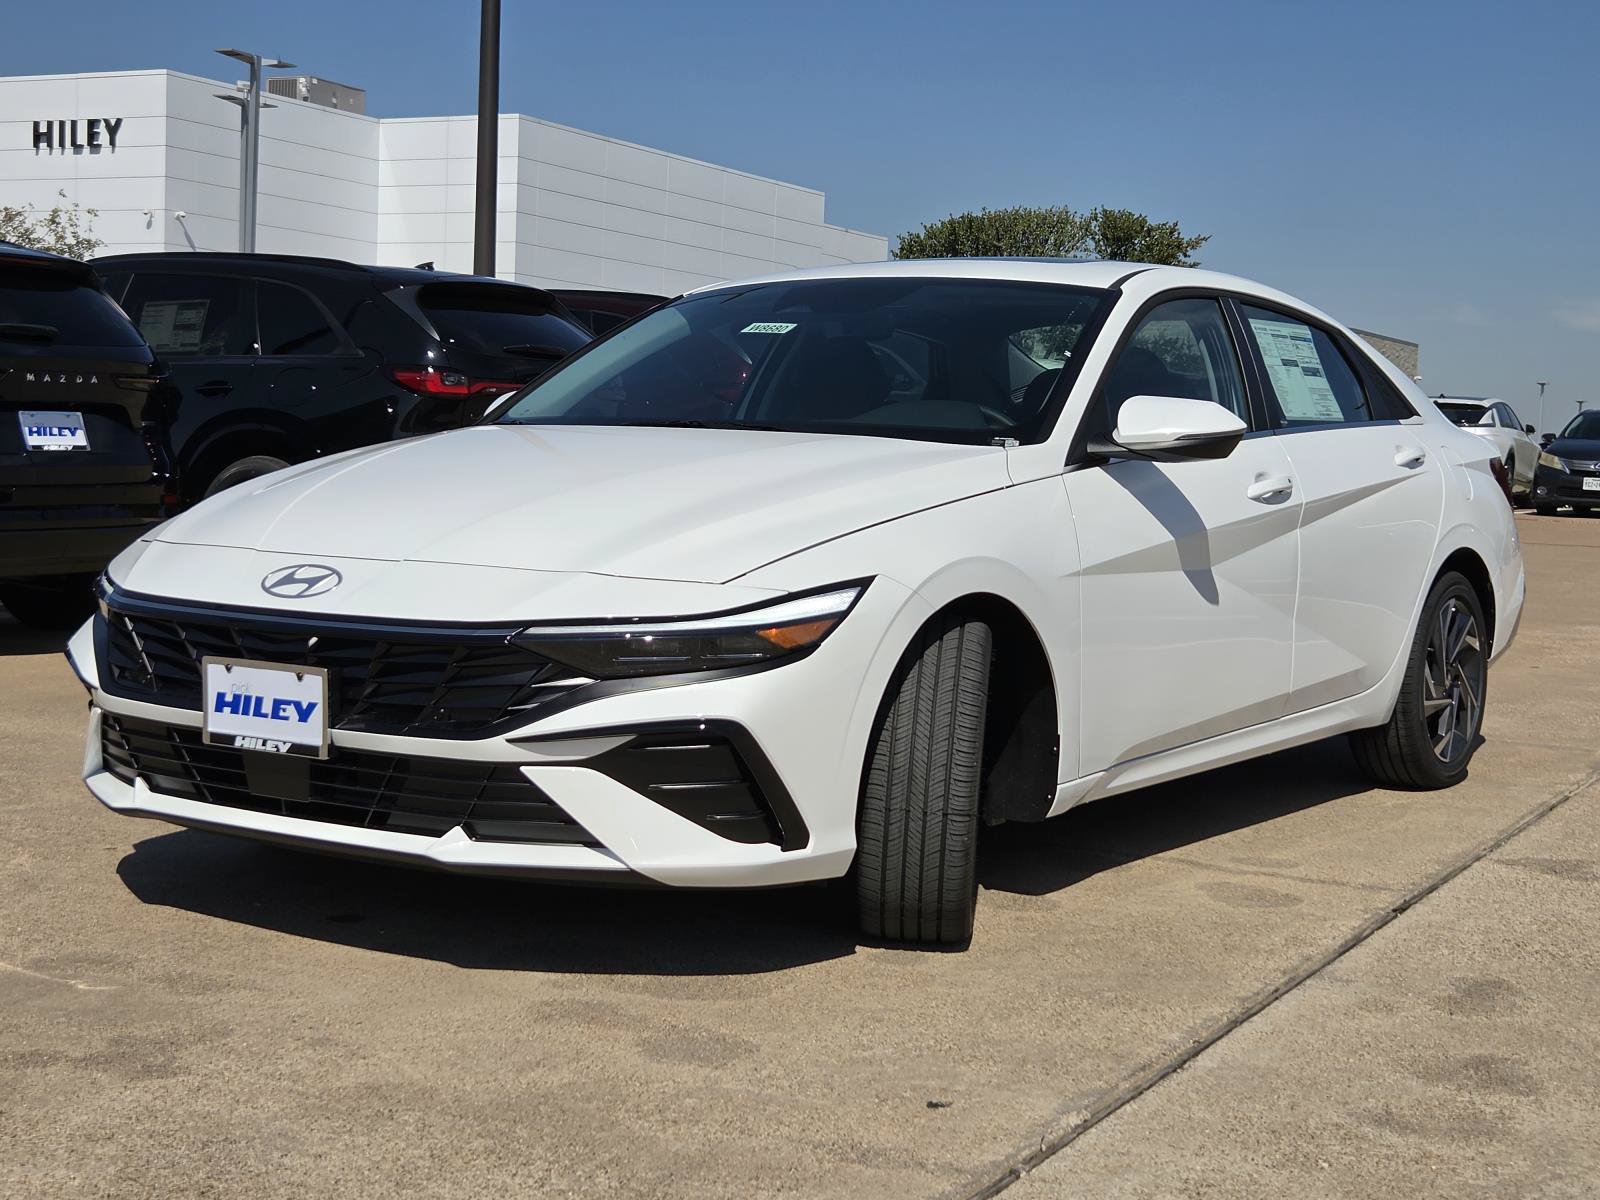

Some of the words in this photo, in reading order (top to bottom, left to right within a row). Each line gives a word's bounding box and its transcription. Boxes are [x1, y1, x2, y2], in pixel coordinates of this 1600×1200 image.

[32, 118, 123, 149] HILEY
[26, 373, 98, 383] MAZDA
[27, 426, 79, 437] HILEY
[214, 691, 319, 723] HILEY
[234, 735, 292, 752] HILEY
